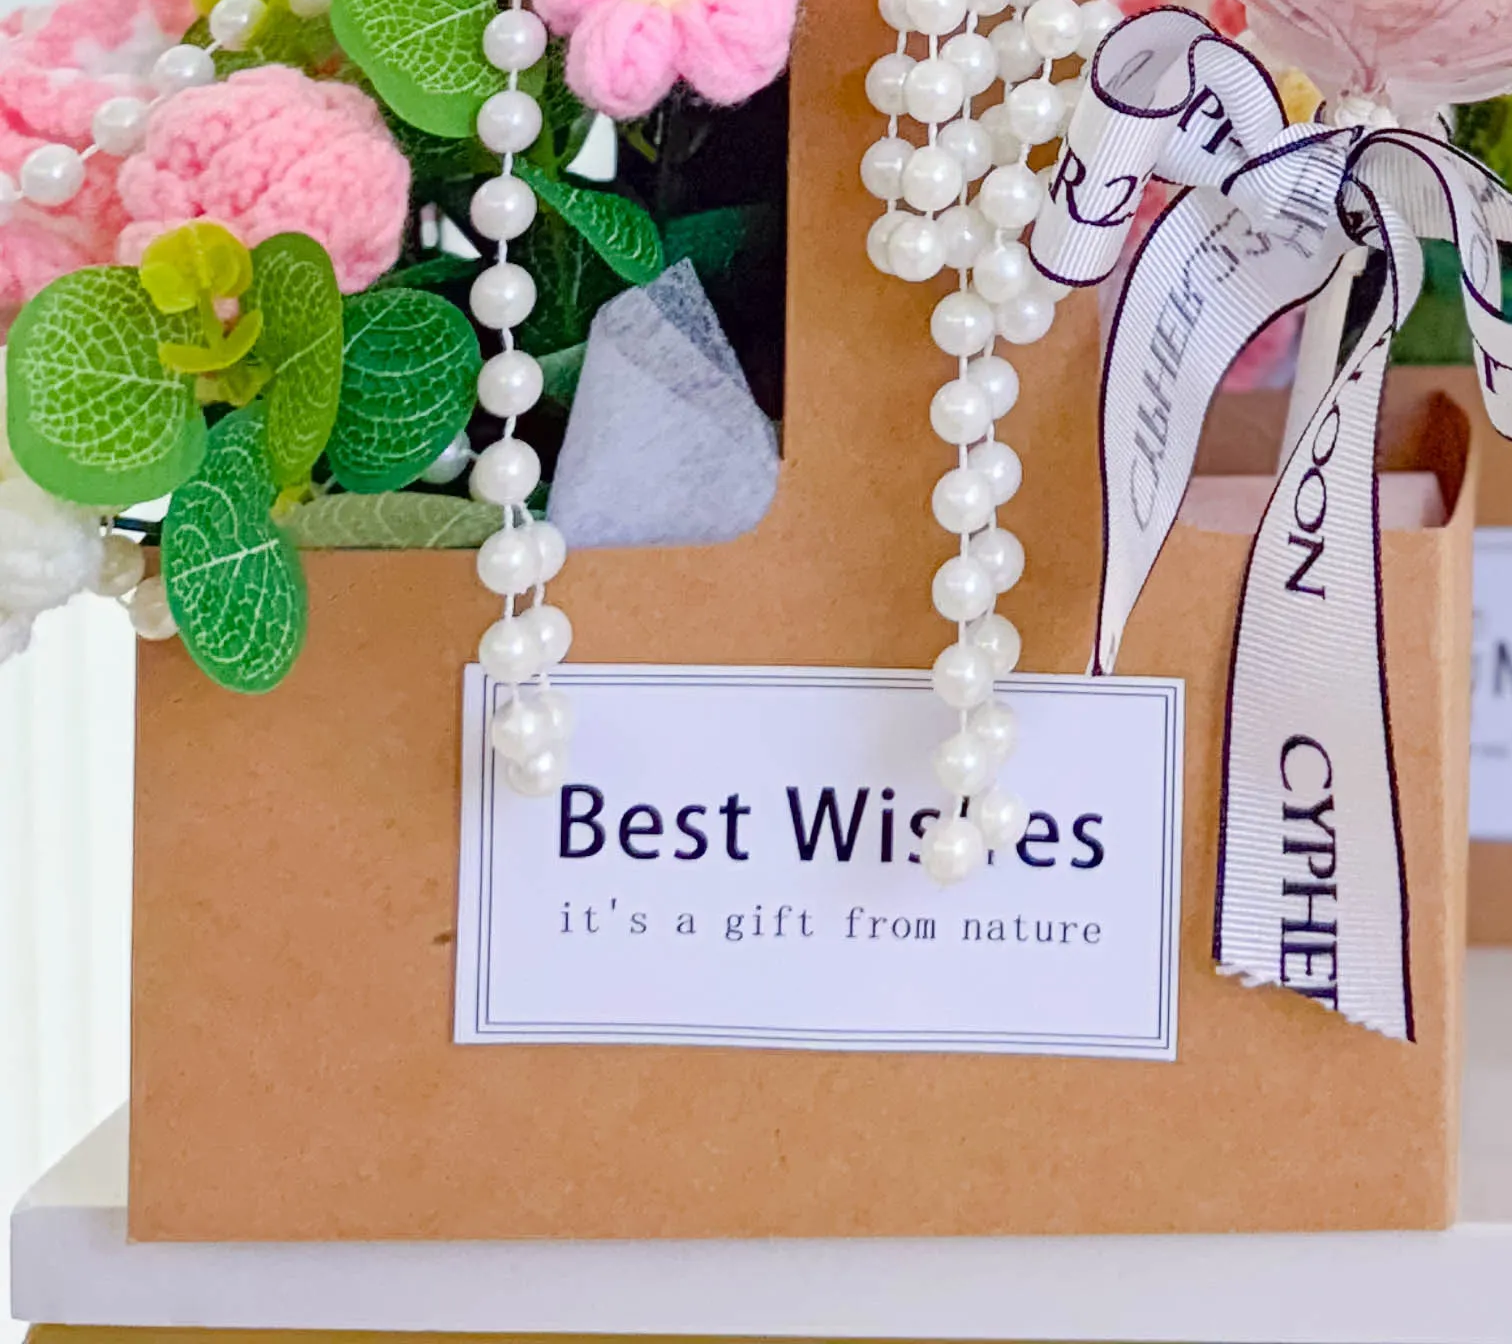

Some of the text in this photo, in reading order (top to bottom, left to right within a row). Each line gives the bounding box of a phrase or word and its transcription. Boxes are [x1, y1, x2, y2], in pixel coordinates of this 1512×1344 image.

[558, 783, 751, 863] Best
[559, 899, 1103, 946] it's a gift from nature
